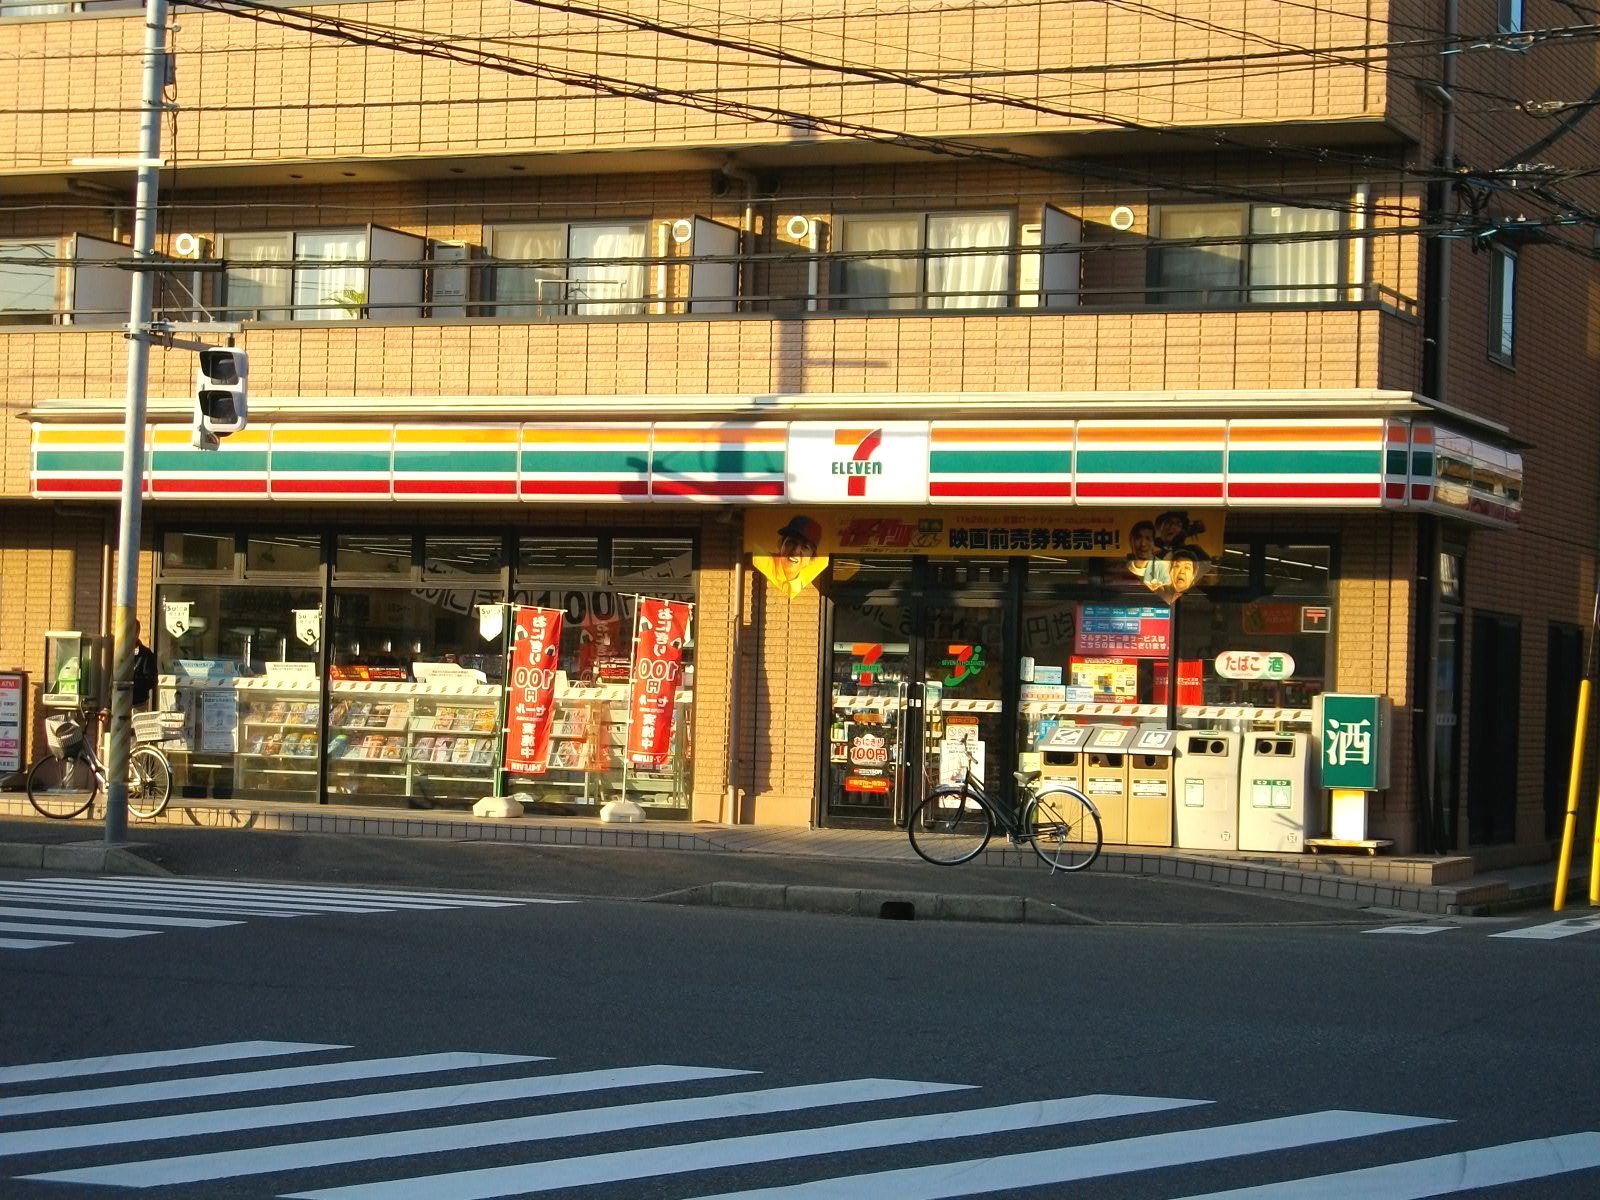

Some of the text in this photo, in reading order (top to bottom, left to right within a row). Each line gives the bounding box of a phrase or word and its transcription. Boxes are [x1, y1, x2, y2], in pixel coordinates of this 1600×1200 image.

[834, 428, 882, 496] 7
[949, 528, 1121, 550] 映画前売券発売中!
[1226, 656, 1283, 672] たばこ 酒
[853, 737, 885, 747] おにぎり
[1326, 718, 1371, 766] 酒
[851, 747, 887, 761] 100円
